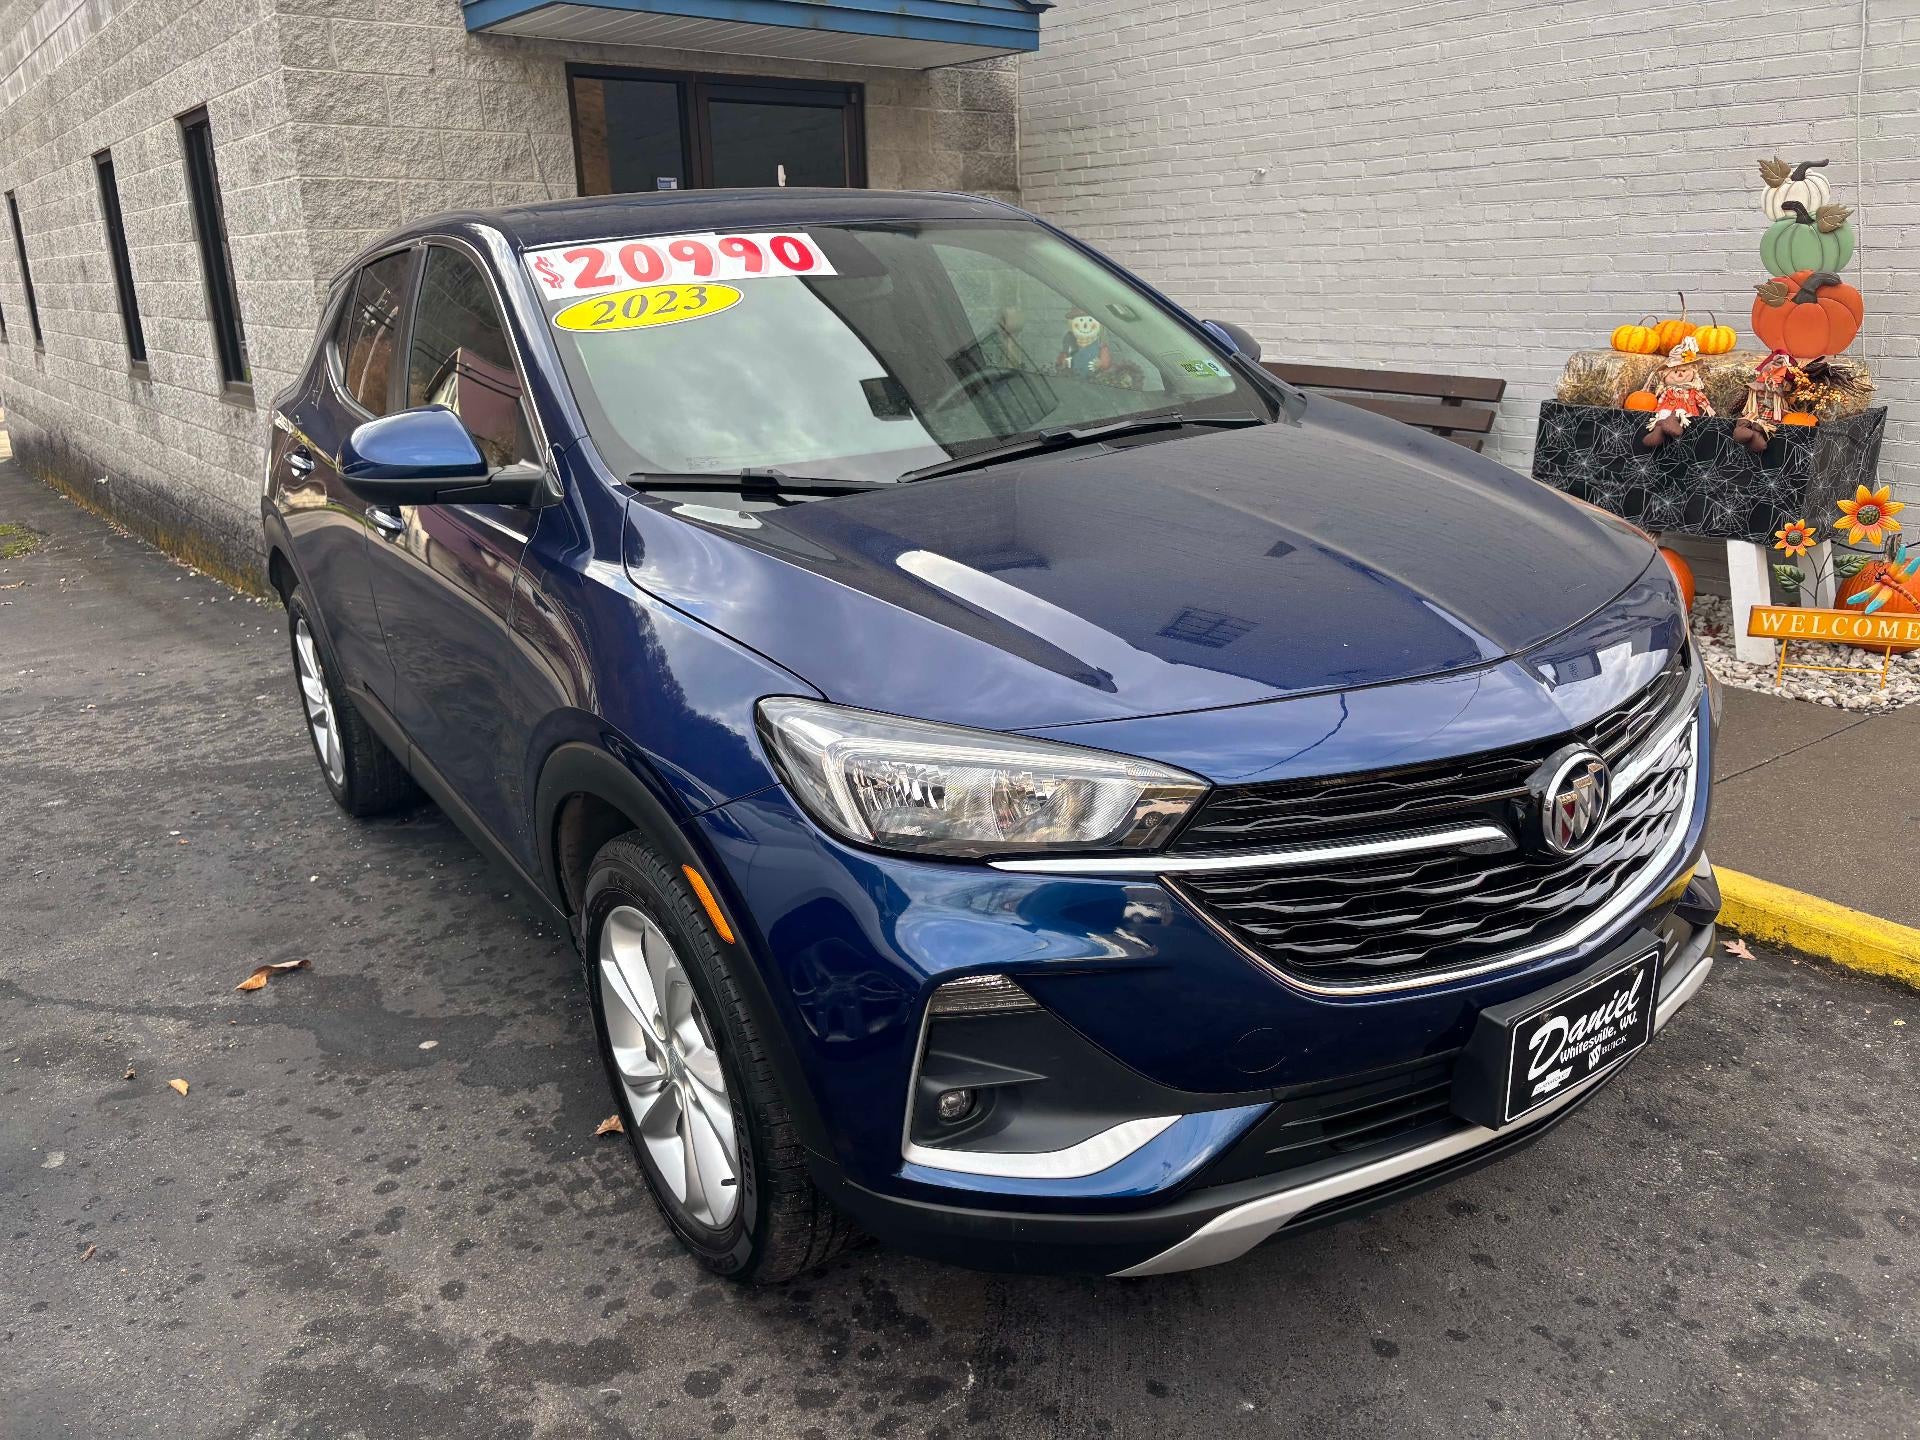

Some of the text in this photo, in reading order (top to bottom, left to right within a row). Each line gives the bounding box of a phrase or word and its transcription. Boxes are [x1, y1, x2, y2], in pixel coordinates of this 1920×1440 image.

[534, 235, 820, 289] $20990
[590, 286, 708, 326] 2023
[1760, 612, 1920, 641] WELCOME
[1527, 968, 1644, 1081] Daniel
[1600, 1034, 1628, 1056] BUICK
